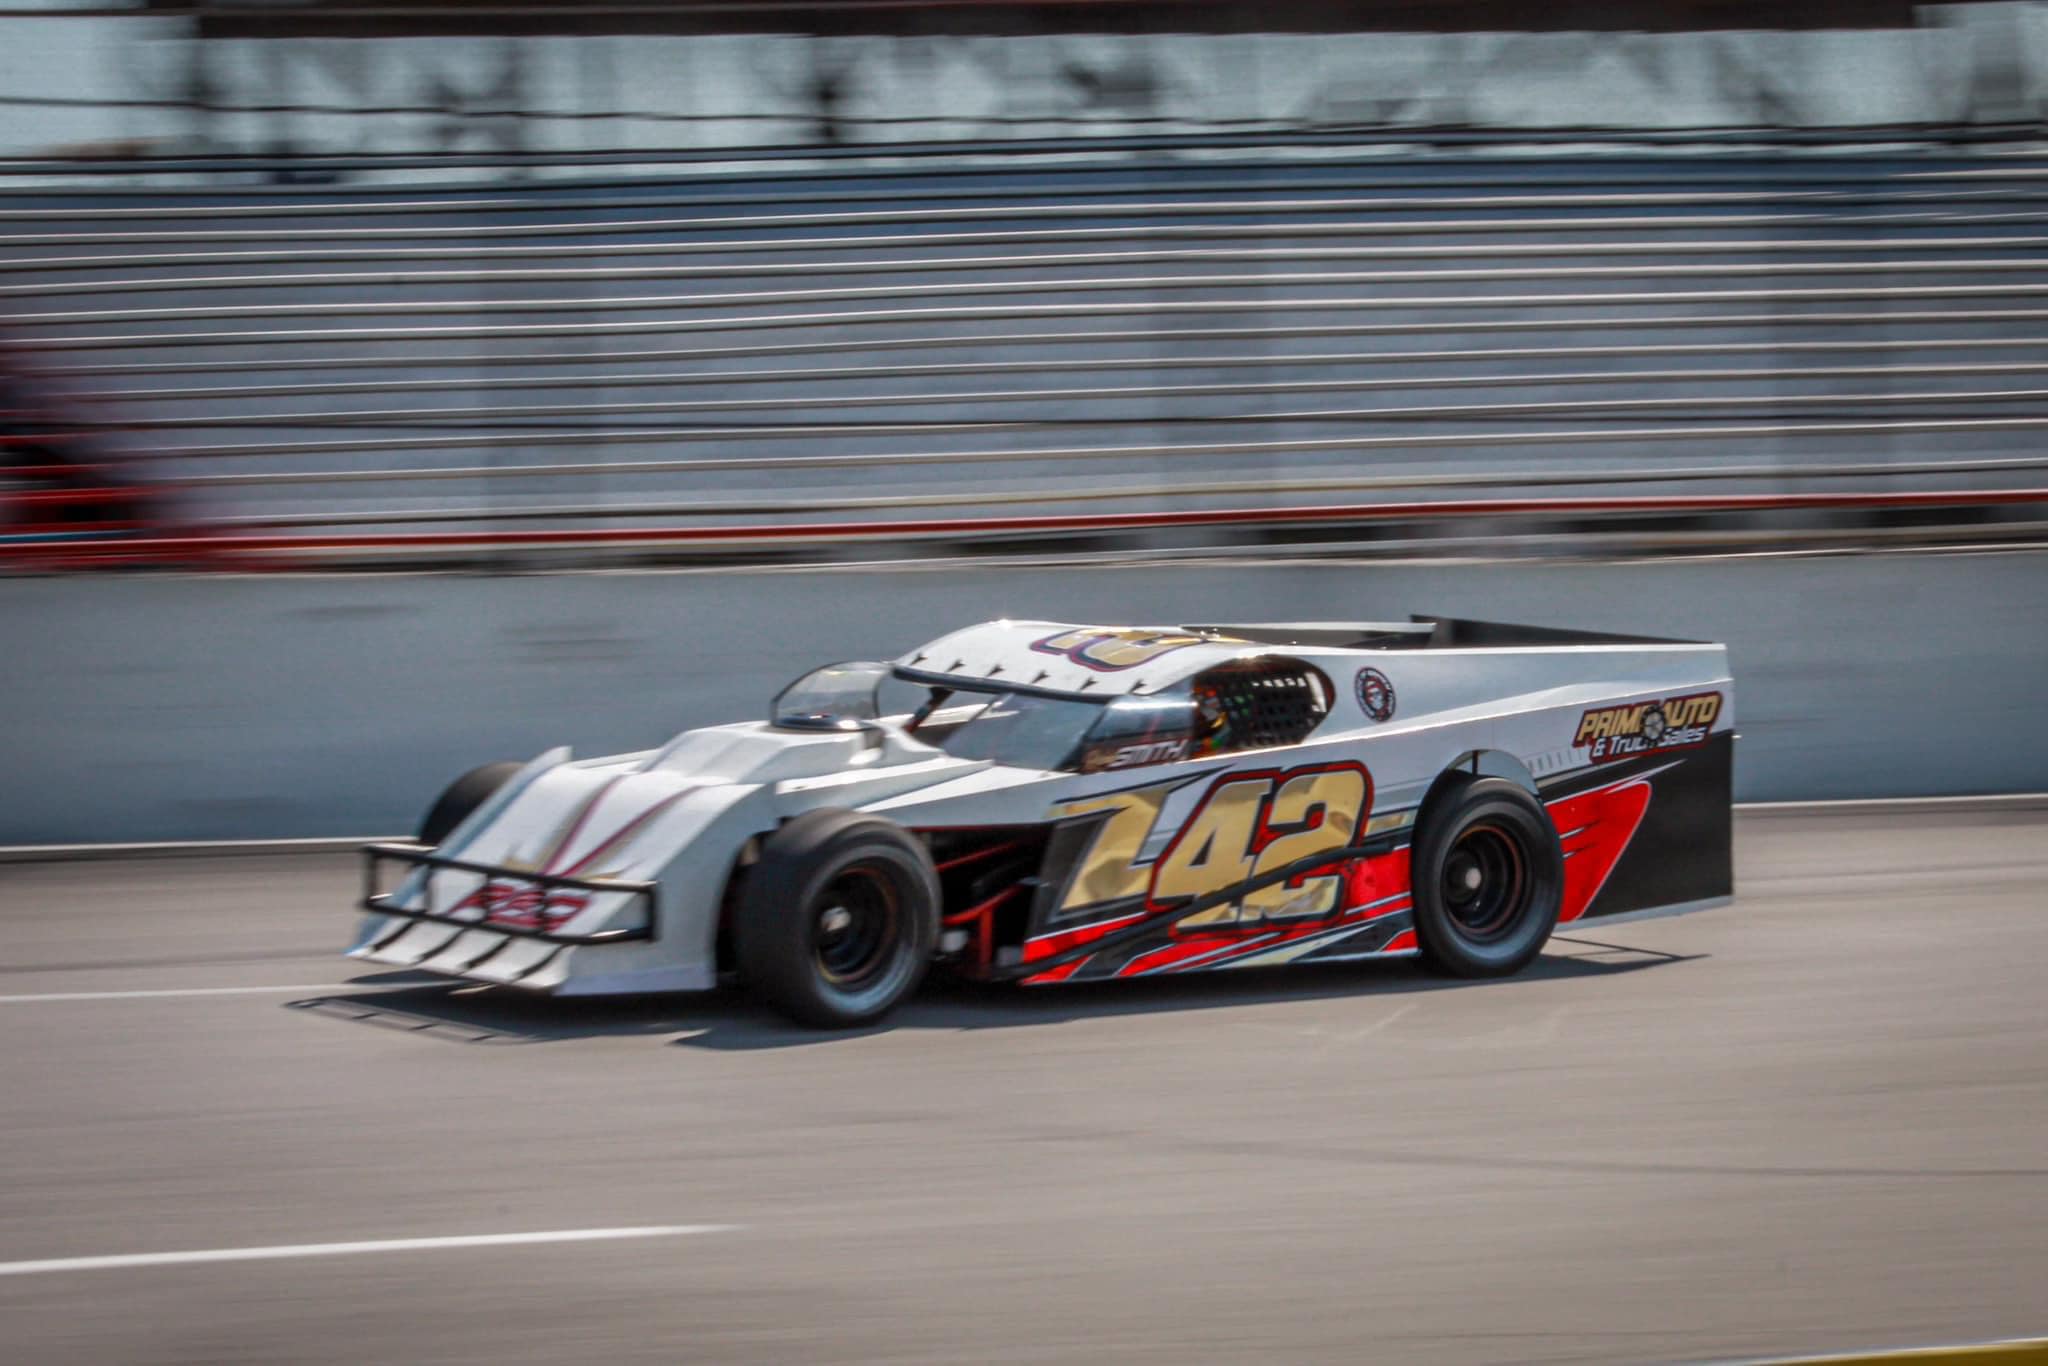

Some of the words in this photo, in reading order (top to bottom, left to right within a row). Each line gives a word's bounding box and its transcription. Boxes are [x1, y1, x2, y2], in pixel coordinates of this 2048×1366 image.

[1577, 705, 1657, 742] PRIM
[1663, 696, 1720, 728] AUTO
[1610, 734, 1656, 755] Truc
